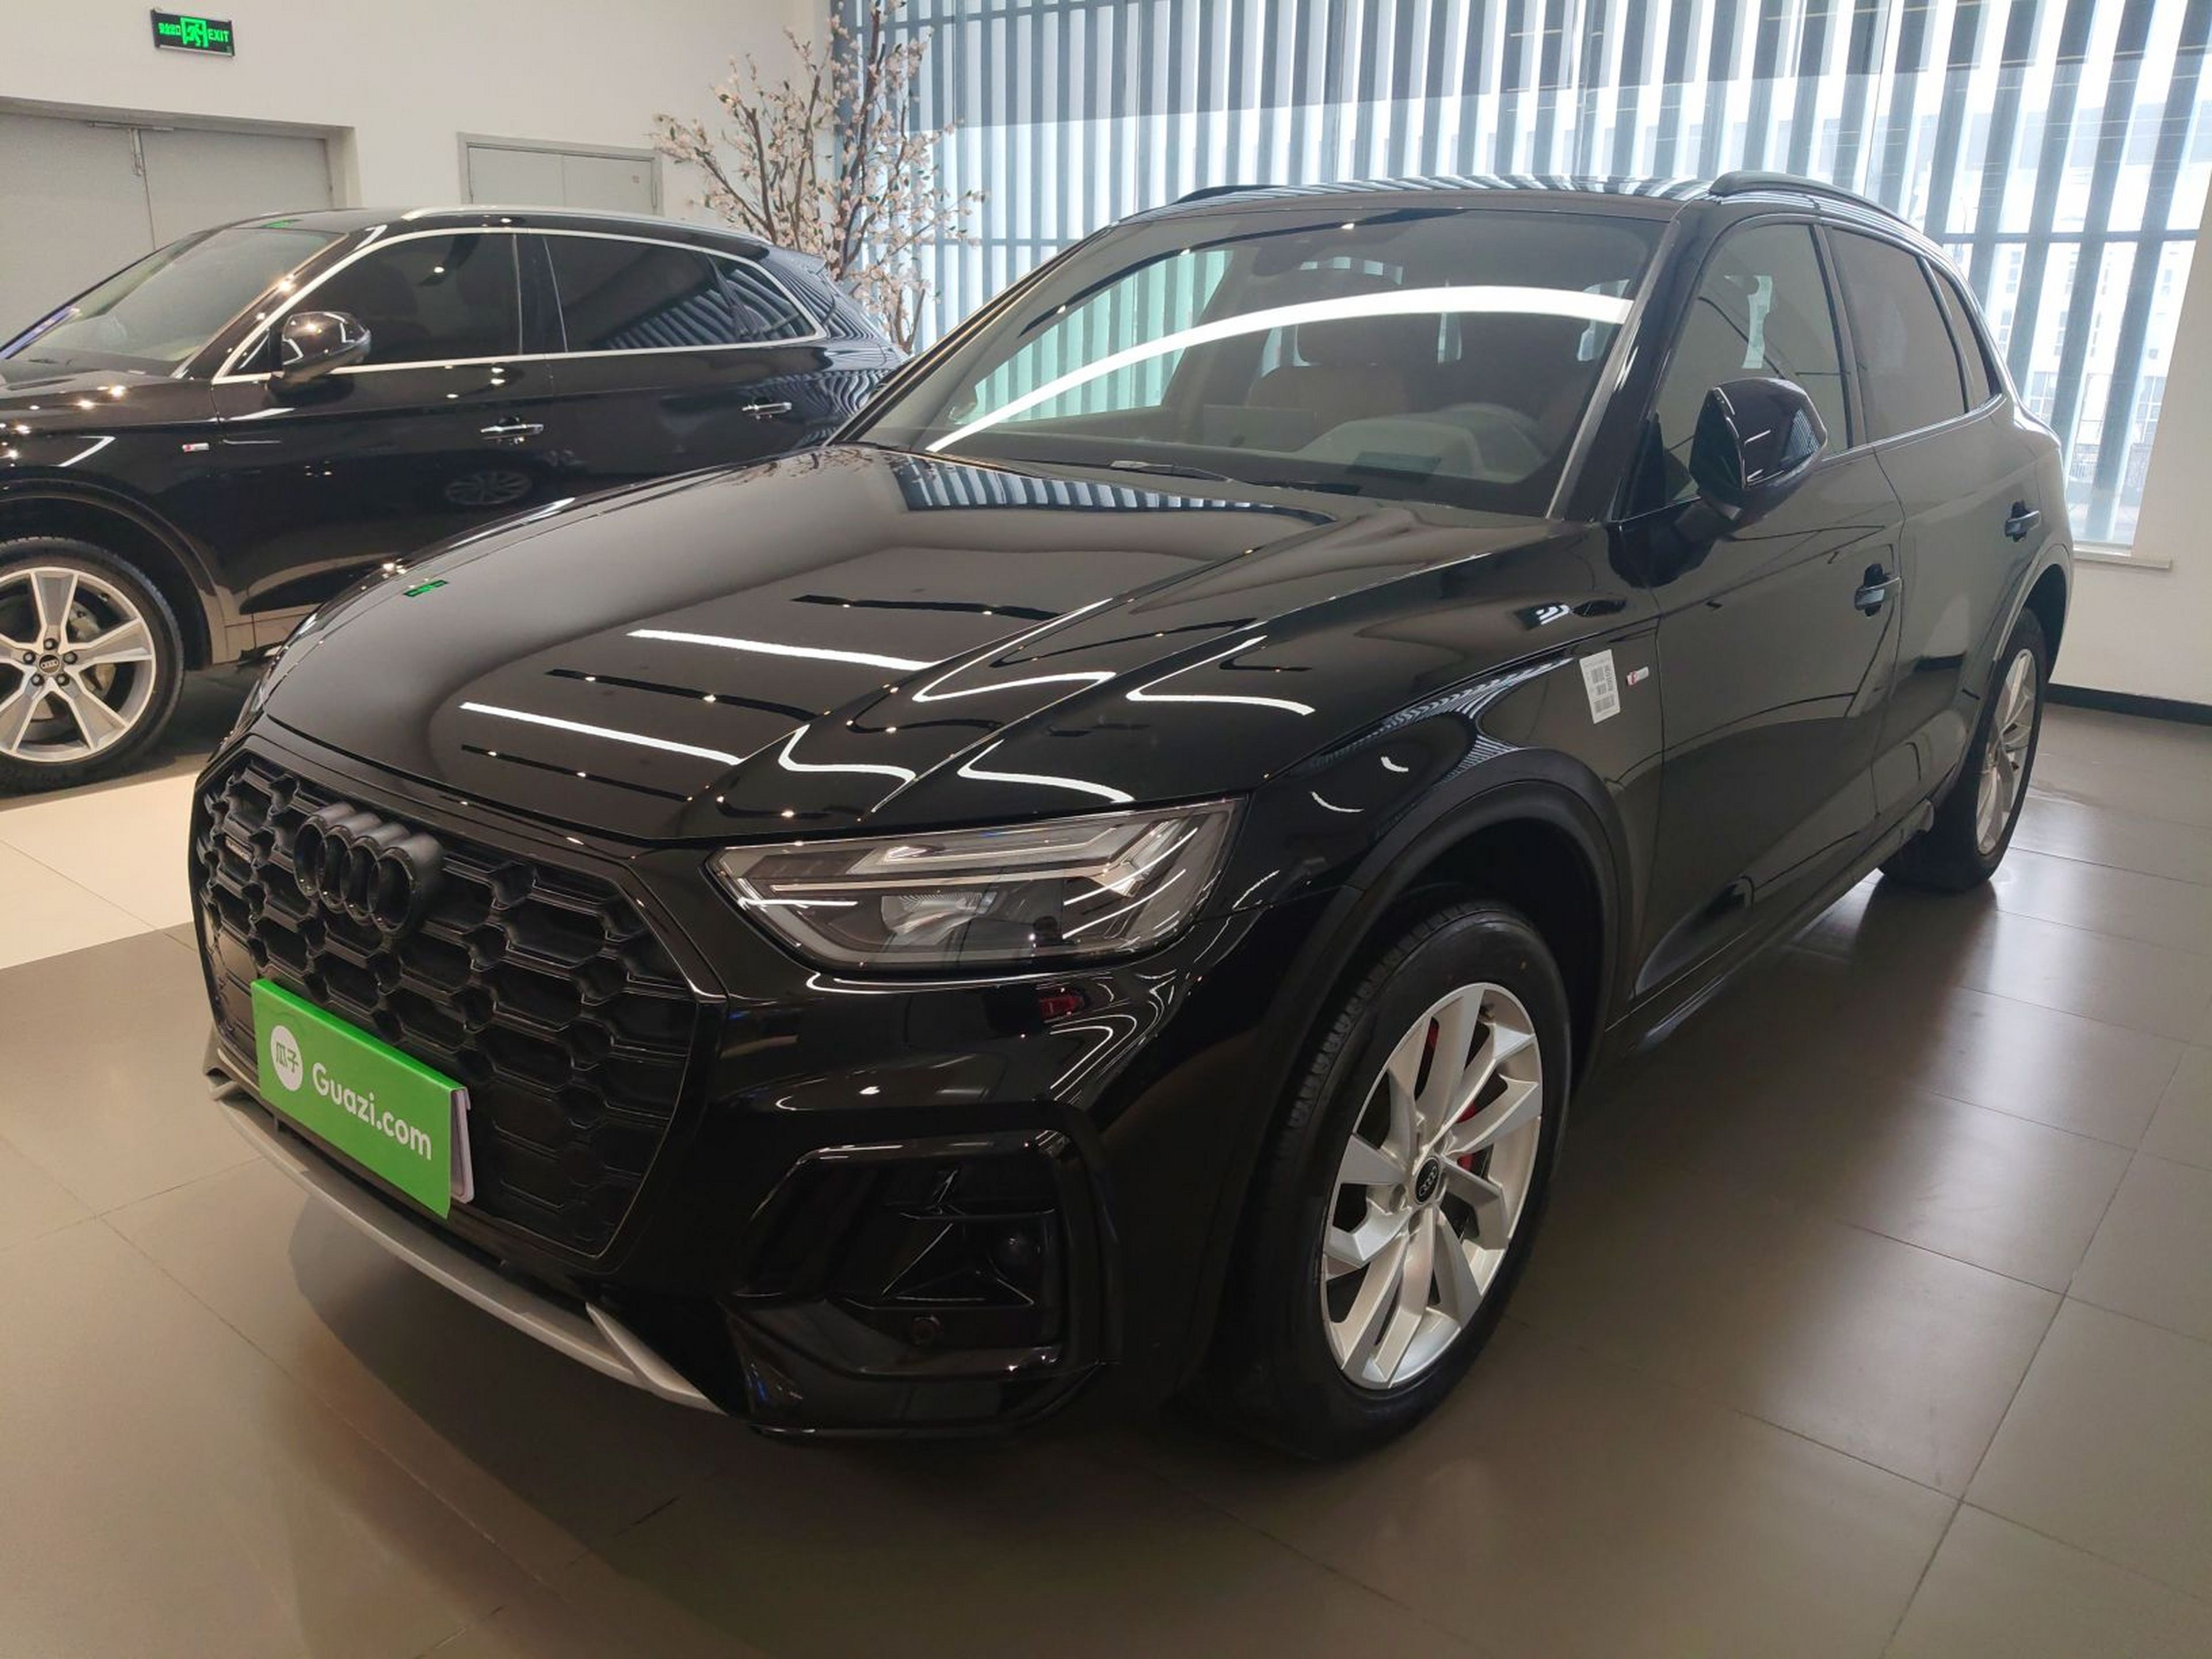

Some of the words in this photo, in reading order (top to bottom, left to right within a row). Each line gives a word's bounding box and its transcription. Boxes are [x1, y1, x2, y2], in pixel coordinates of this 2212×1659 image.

[208, 29, 229, 42] EXIT
[276, 1041, 299, 1073] 瓜子
[312, 1062, 432, 1160] Guazi.com
